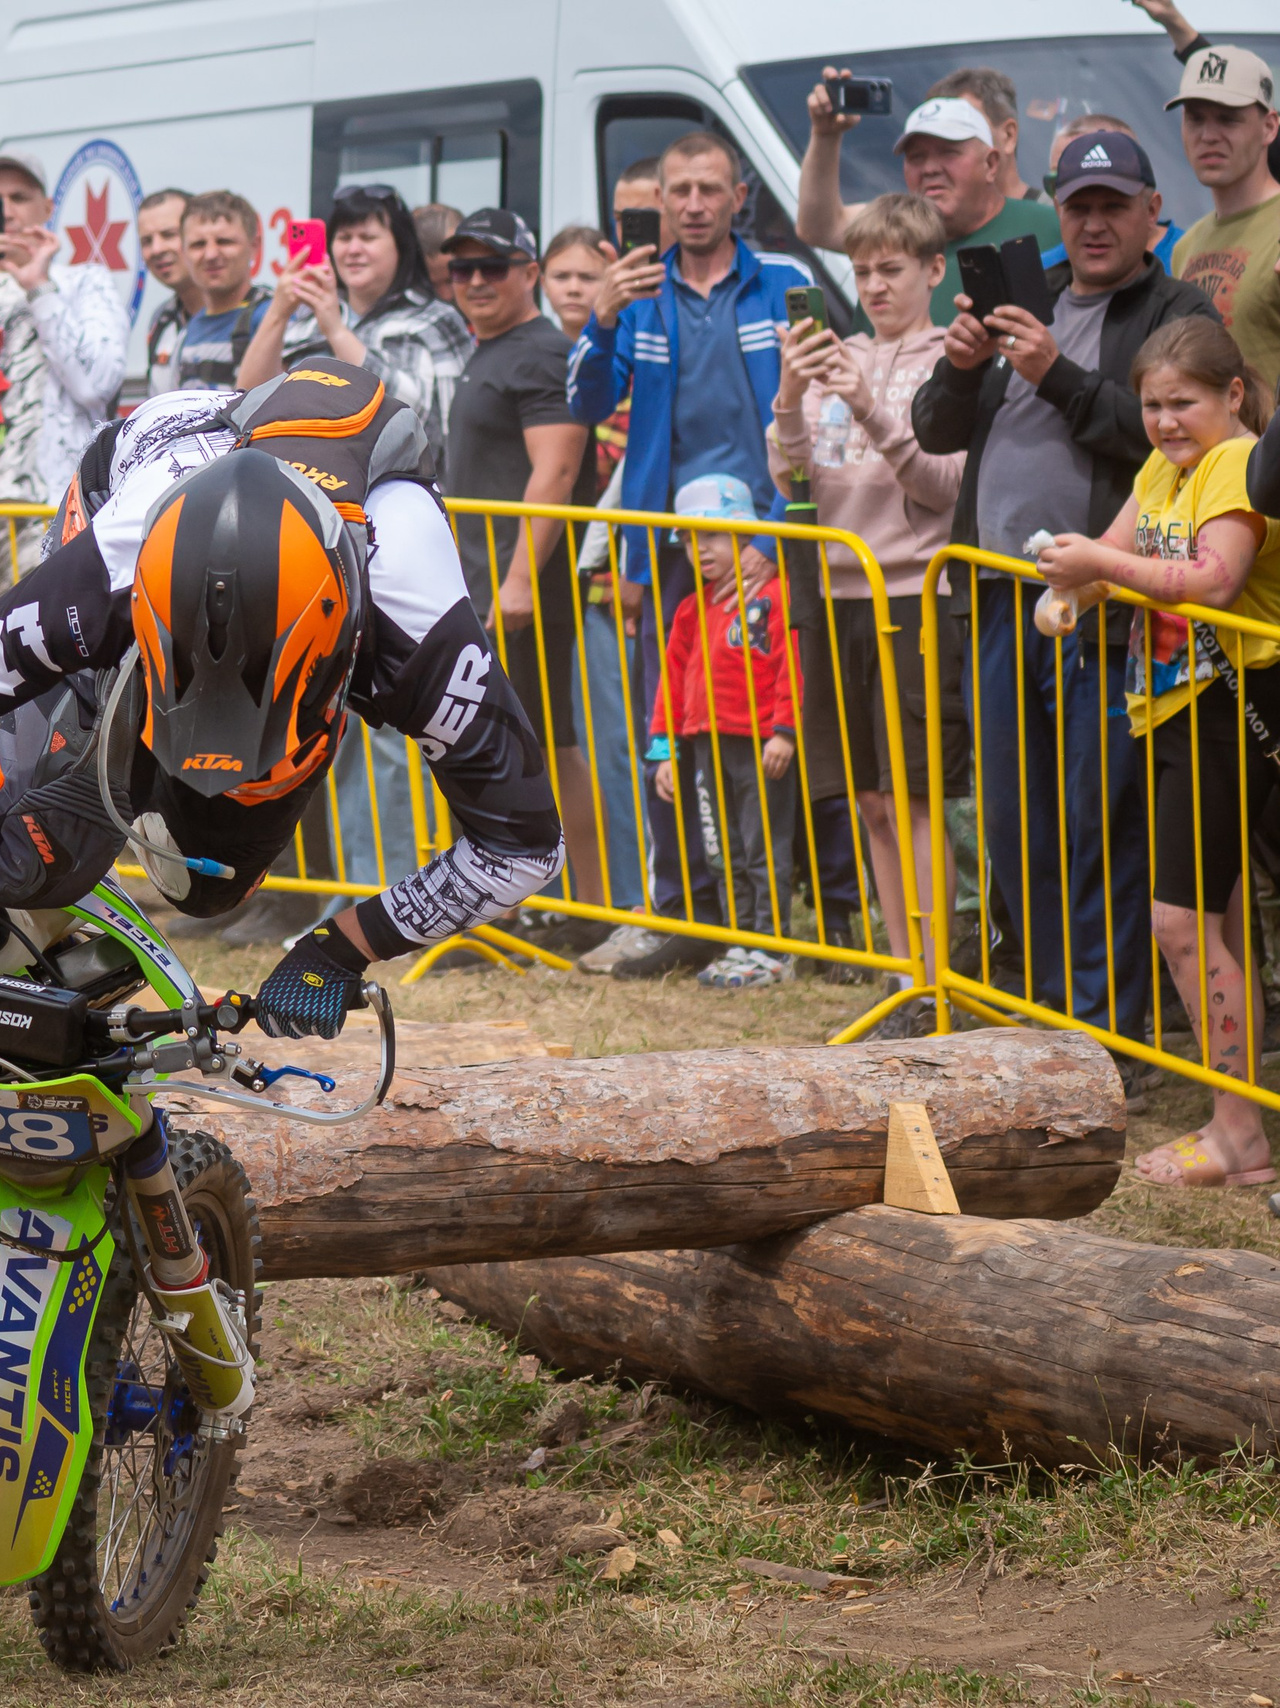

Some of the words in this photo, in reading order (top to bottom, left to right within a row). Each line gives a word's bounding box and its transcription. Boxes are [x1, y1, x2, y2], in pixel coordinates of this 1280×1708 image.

[1081, 159, 1112, 168] adidas
[66, 605, 90, 658] MOTO
[1245, 701, 1270, 741] LOVE
[181, 753, 243, 772] KTM
[21, 815, 55, 864] KTM
[104, 906, 172, 968] EXCEL
[43, 1100, 83, 1110] SRT
[64, 1376, 72, 1413] EXCEL
